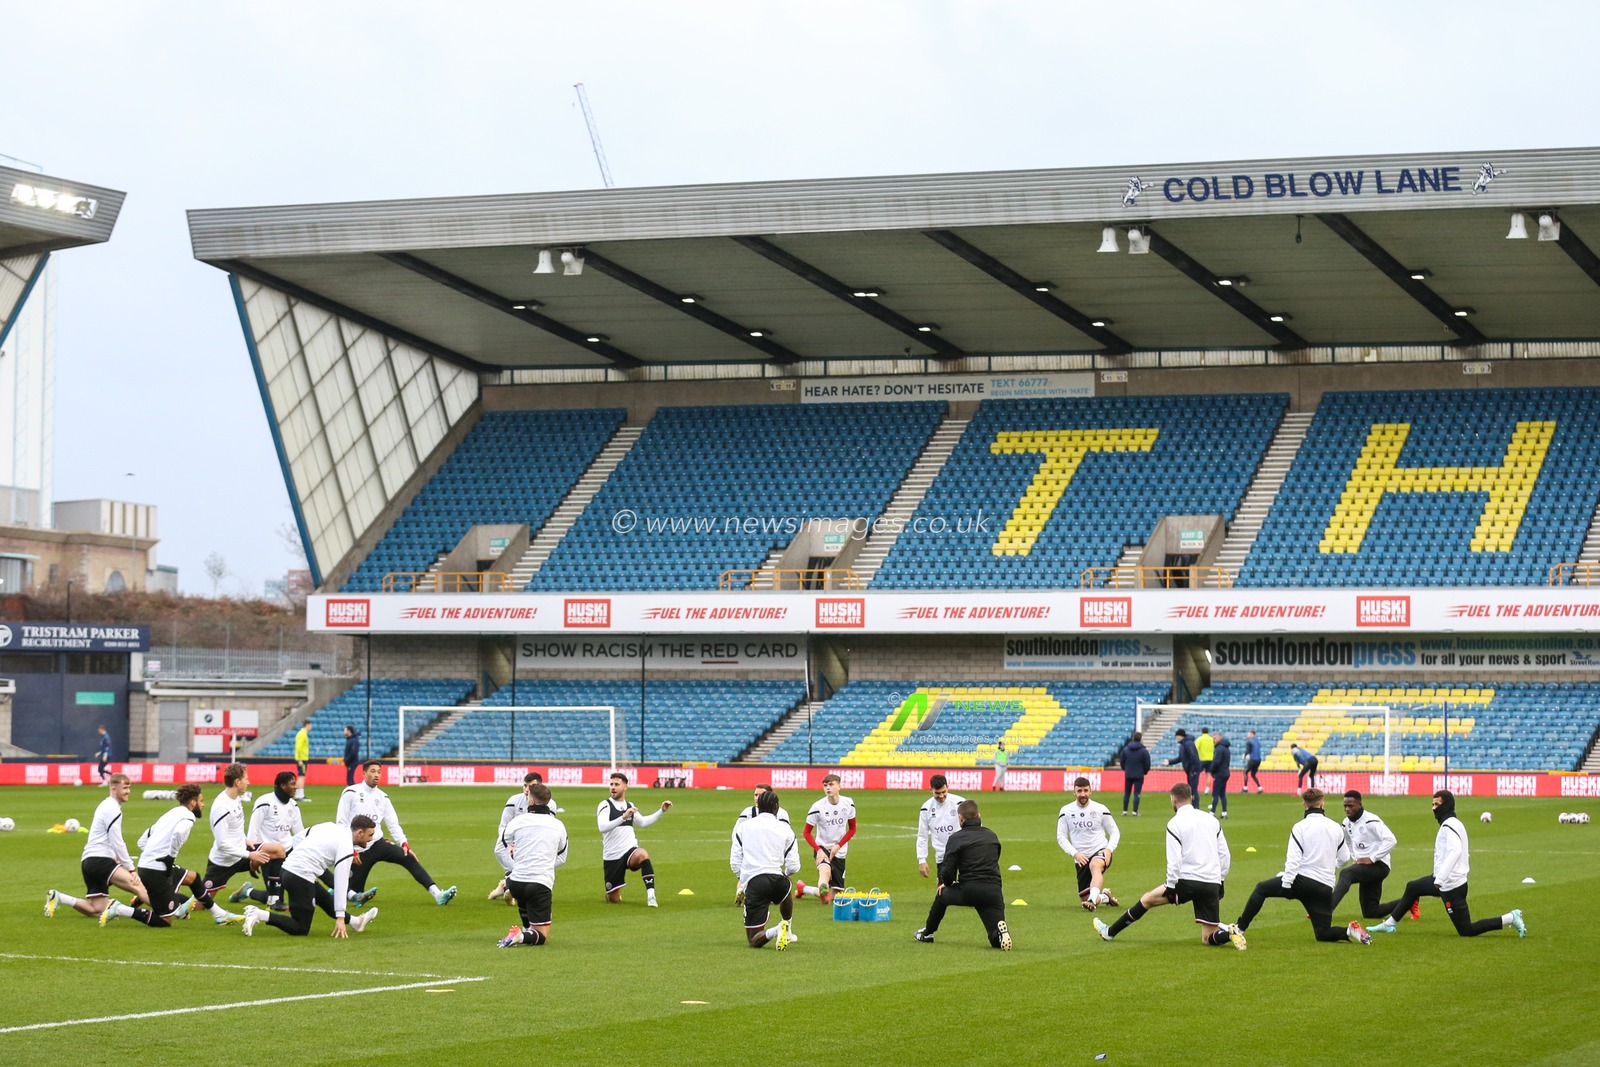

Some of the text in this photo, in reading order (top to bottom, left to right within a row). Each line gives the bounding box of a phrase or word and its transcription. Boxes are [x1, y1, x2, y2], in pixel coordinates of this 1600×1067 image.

[1163, 167, 1462, 202] COLD BLOW LANE
[991, 378, 1049, 388] TEXT 66777
[805, 383, 984, 397] HEAR HATE? DON'T HESITATE
[329, 602, 367, 617] HUSKI
[399, 607, 538, 619] FUEL THE ADVENTURE!
[567, 602, 608, 617] HUSKI
[643, 607, 788, 619] FUEL THE ADVENTURE!
[819, 602, 862, 617] HUSKI
[898, 606, 1051, 619] FUEL THE ADVENTURE!
[1084, 601, 1128, 616] HUSKI
[1165, 605, 1326, 618] FUEL THE ADVENTURE!
[1360, 600, 1407, 615] HUSKI
[1446, 605, 1491, 618] FUEL
[1496, 604, 1522, 617] THE
[329, 616, 367, 624] CHOCOLATE
[567, 616, 608, 624] CHOCOLATE
[819, 616, 862, 624] CHOCOLATE
[1084, 615, 1128, 624] CHOCOLATE
[1360, 615, 1407, 623] CHOCOLATE
[22, 626, 88, 638] TRISTRAM
[90, 628, 140, 639] PARKER
[22, 638, 92, 648] RECRUITMENT
[1006, 636, 1141, 658] southlondonpress
[522, 642, 798, 658] SHOW RACISM THE RED CARD
[1215, 636, 1416, 668] southlondonpress
[1421, 653, 1566, 667] for all your news & sport
[440, 767, 475, 779] HUSKI
[548, 768, 583, 780] HUSKI
[771, 770, 807, 782] HUSKI
[886, 770, 923, 783] HUSKI
[945, 771, 982, 784] HUSKI
[1004, 771, 1042, 784] HUSKI
[1496, 776, 1536, 789] HUSKI
[1496, 788, 1536, 796] CHOCOLATE
[826, 817, 844, 826] YELO
[934, 824, 954, 833] YELO
